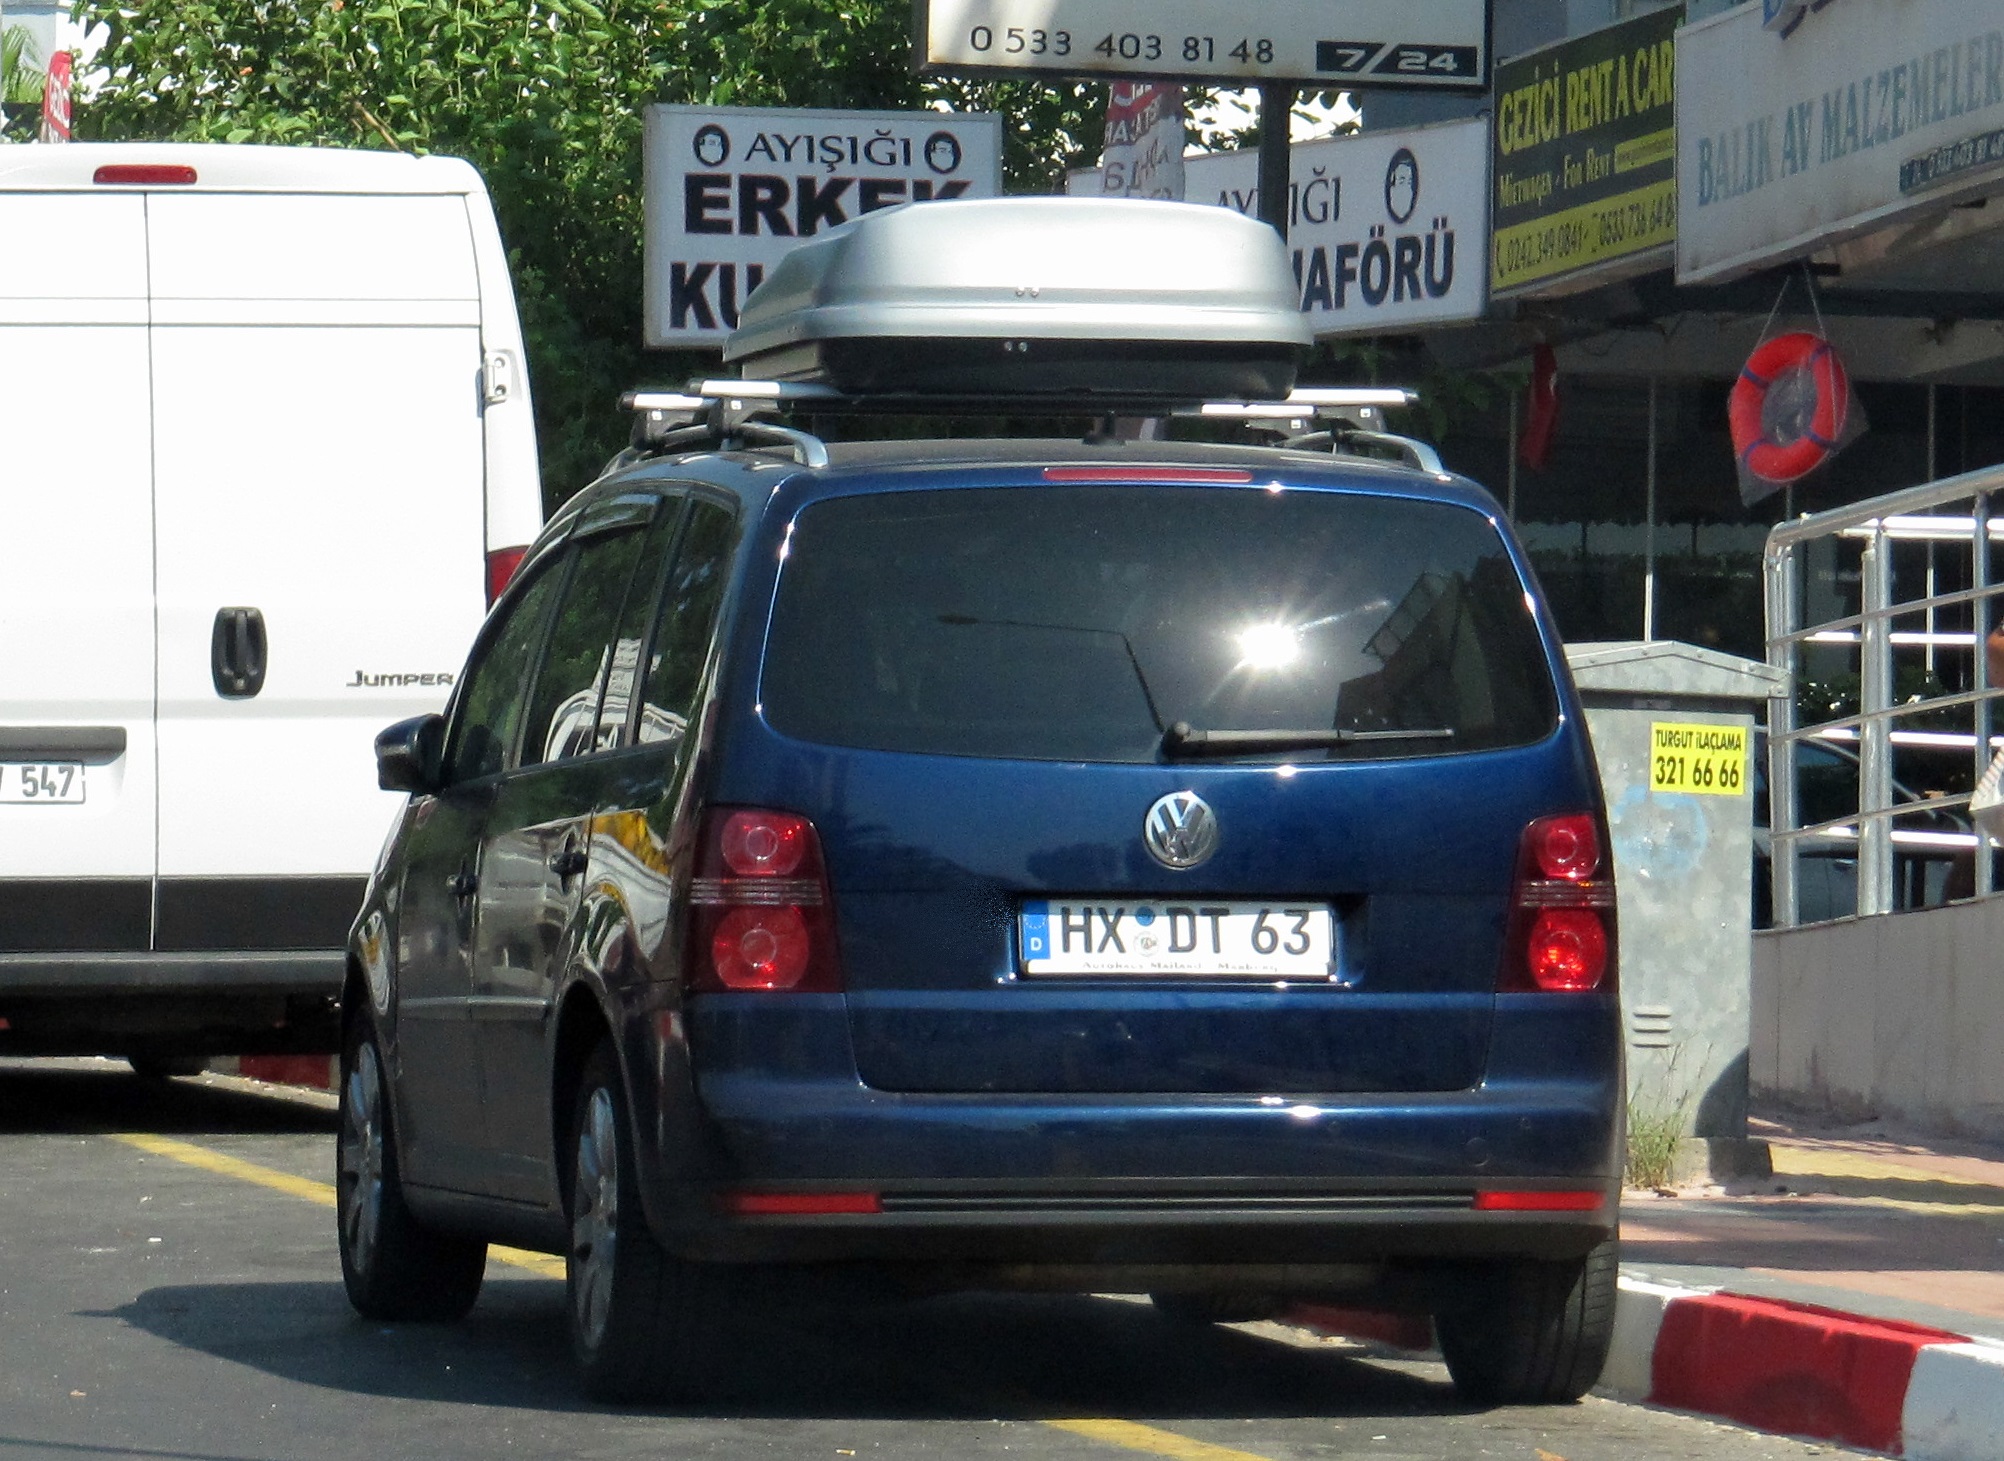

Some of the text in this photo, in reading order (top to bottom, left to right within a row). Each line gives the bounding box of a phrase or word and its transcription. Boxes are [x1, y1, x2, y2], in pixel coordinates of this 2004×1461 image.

[970, 26, 1274, 65] 0 533 403 81 48
[1500, 58, 1560, 156] GEZİCİ
[1566, 59, 1614, 134] RENT
[1615, 55, 1630, 119] A
[1633, 40, 1673, 113] CAR
[745, 129, 912, 173] AYIŞIĞI
[1699, 114, 1773, 206] BALIK
[1783, 101, 1814, 177] AV
[1655, 729, 1693, 749] TURGUT
[21, 765, 75, 797] 547
[1655, 756, 1739, 788] 321 66 66
[1030, 906, 1312, 955] D HX DT 63
